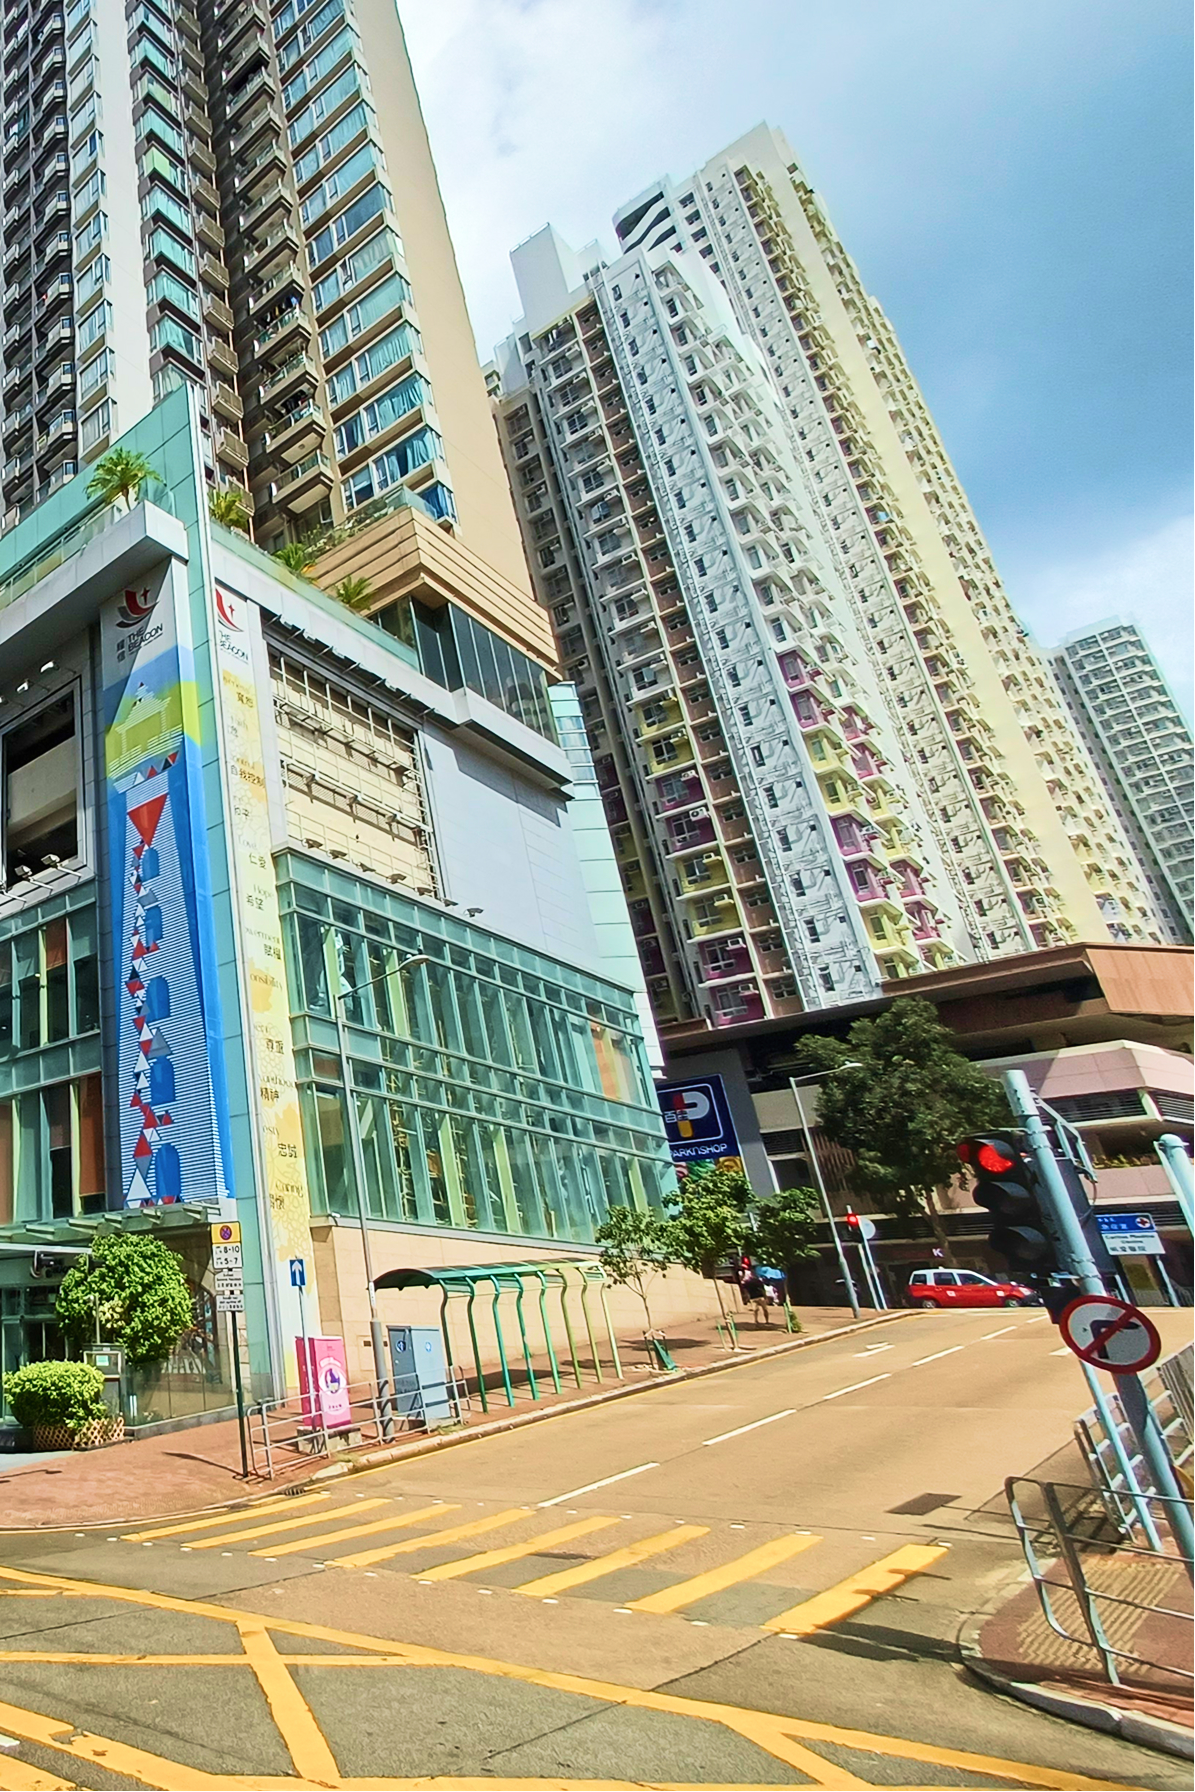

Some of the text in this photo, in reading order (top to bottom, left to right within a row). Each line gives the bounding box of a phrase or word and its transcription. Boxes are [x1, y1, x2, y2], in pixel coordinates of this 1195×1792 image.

[128, 626, 144, 642] THE
[128, 623, 163, 652] BEACON
[671, 1143, 728, 1158] ARKnSHOP
